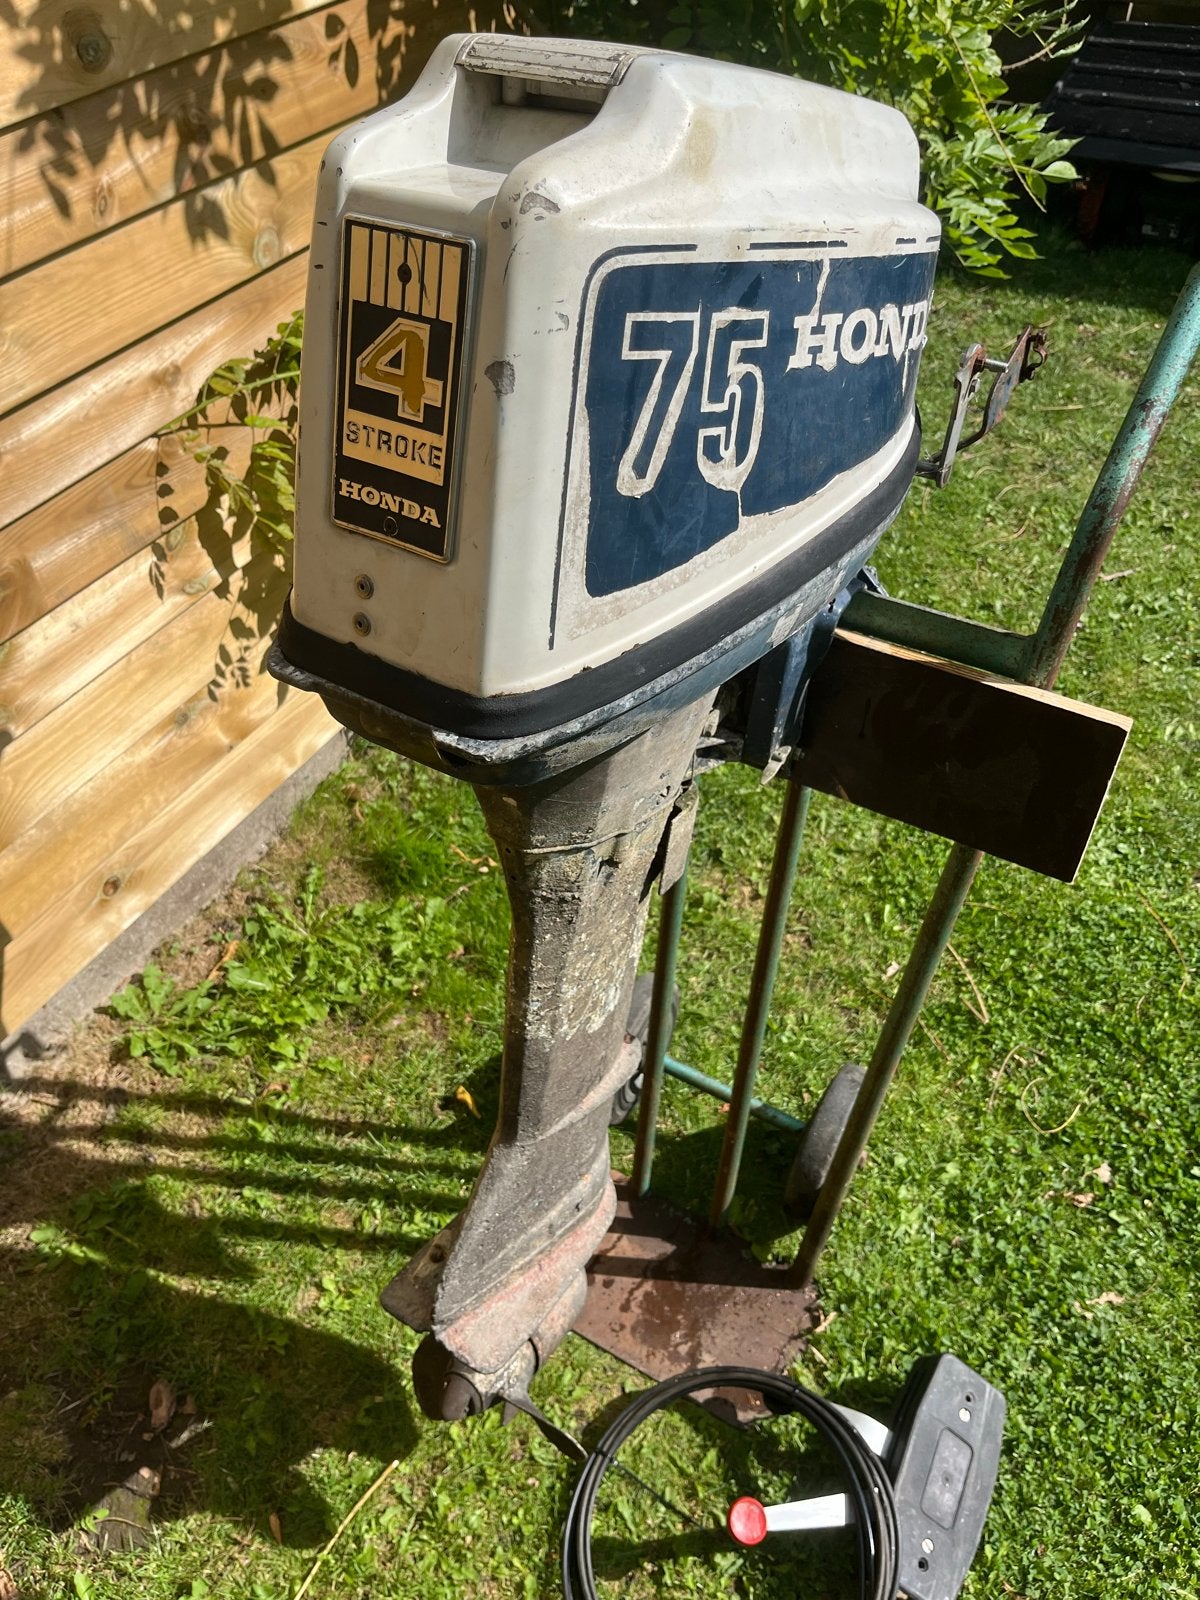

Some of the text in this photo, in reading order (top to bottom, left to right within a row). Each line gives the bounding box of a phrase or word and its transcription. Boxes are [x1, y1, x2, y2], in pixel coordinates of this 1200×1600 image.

[355, 317, 444, 423] 4
[786, 300, 928, 372] HOND
[616, 306, 769, 497] 75
[345, 420, 443, 470] STROKE
[338, 477, 442, 528] HONDA
